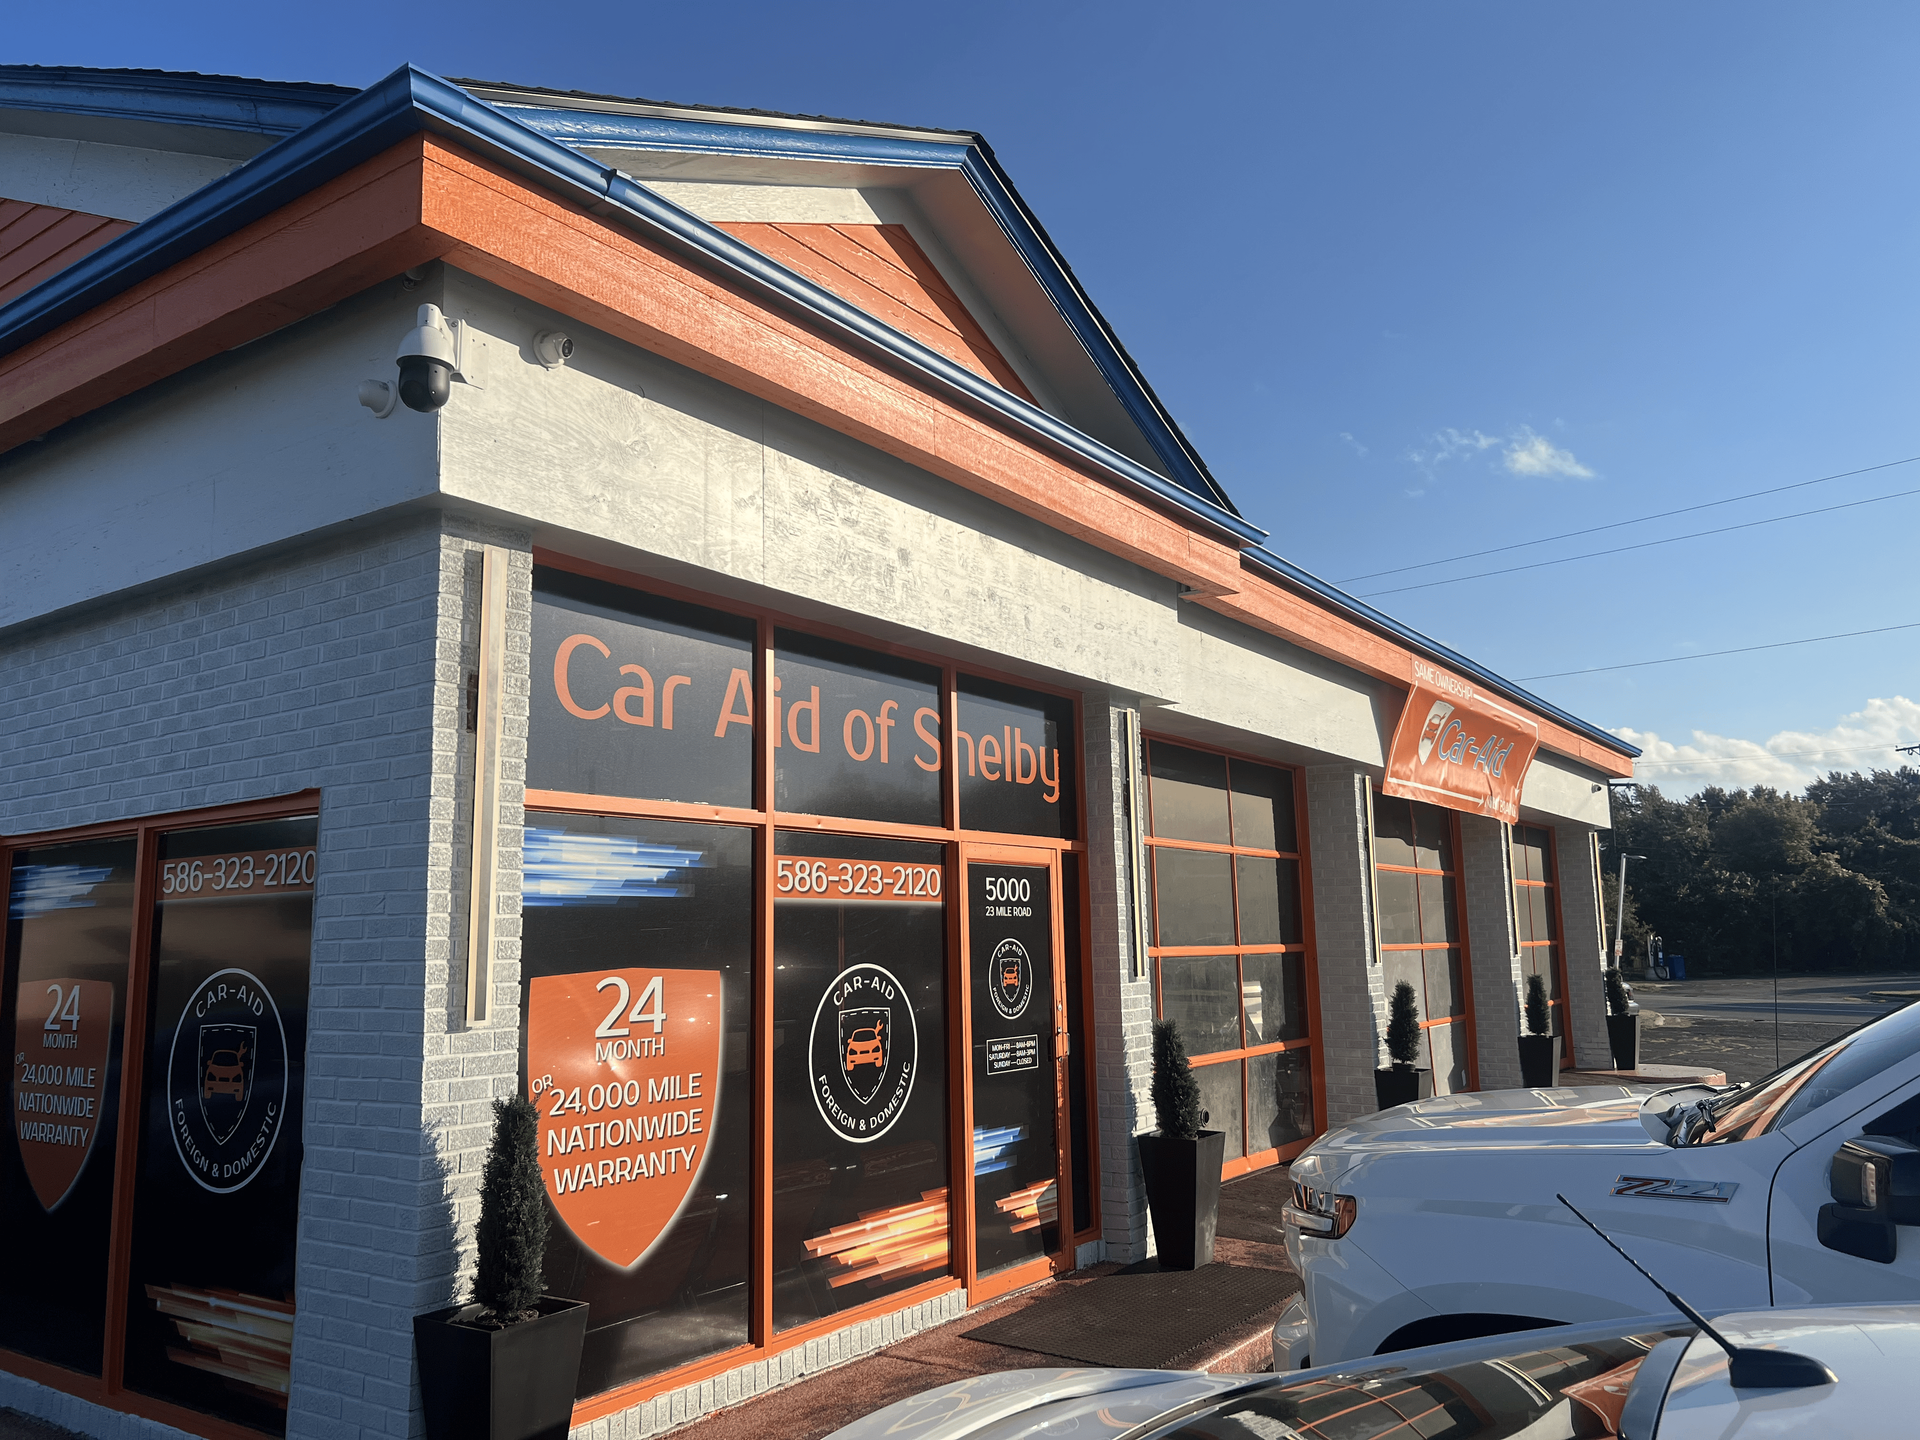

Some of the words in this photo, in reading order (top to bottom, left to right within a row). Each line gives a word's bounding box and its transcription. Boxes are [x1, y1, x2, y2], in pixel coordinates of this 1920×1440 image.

[1414, 660, 1435, 685] SAME
[553, 633, 691, 731] Car
[714, 667, 820, 754] Aid
[843, 699, 899, 764] of
[1438, 718, 1515, 778] Car-Aid
[162, 850, 316, 894] 586-323-2120
[777, 860, 941, 897] 586-323-2120
[985, 877, 1031, 902] 5000
[985, 906, 995, 917] 23
[995, 906, 1012, 917] MILE
[1013, 906, 1032, 917] ROAD
[997, 943, 1023, 958] CAR-AID
[195, 983, 265, 1018] CAR-AID
[833, 975, 896, 1006] CAR-AID
[992, 986, 1008, 1013] FOREIGN
[1012, 983, 1030, 1014] DOMESTIC
[44, 984, 81, 1032] 24
[595, 975, 667, 1038] 24
[43, 1033, 78, 1050] MONTH
[595, 1037, 665, 1062] MONTH
[15, 1051, 25, 1065] OR
[21, 1063, 63, 1088] 24,000
[66, 1067, 96, 1088] MILE
[531, 1074, 553, 1095] OR
[18, 1092, 95, 1118] NATIONWIDE
[549, 1080, 640, 1116] 24,000
[648, 1072, 702, 1103] MILE
[818, 1074, 856, 1131] FOREIGN
[859, 1119, 867, 1131] &
[870, 1061, 911, 1130] DOMESTIC
[19, 1120, 89, 1148] WARRANTY
[175, 1098, 209, 1173] FOREIGN
[211, 1163, 219, 1178] &
[223, 1101, 277, 1178] DOMESTIC
[547, 1108, 703, 1156] NATIONWIDE
[553, 1145, 697, 1195] WARRANTY
[1609, 1174, 1740, 1205] Z71
